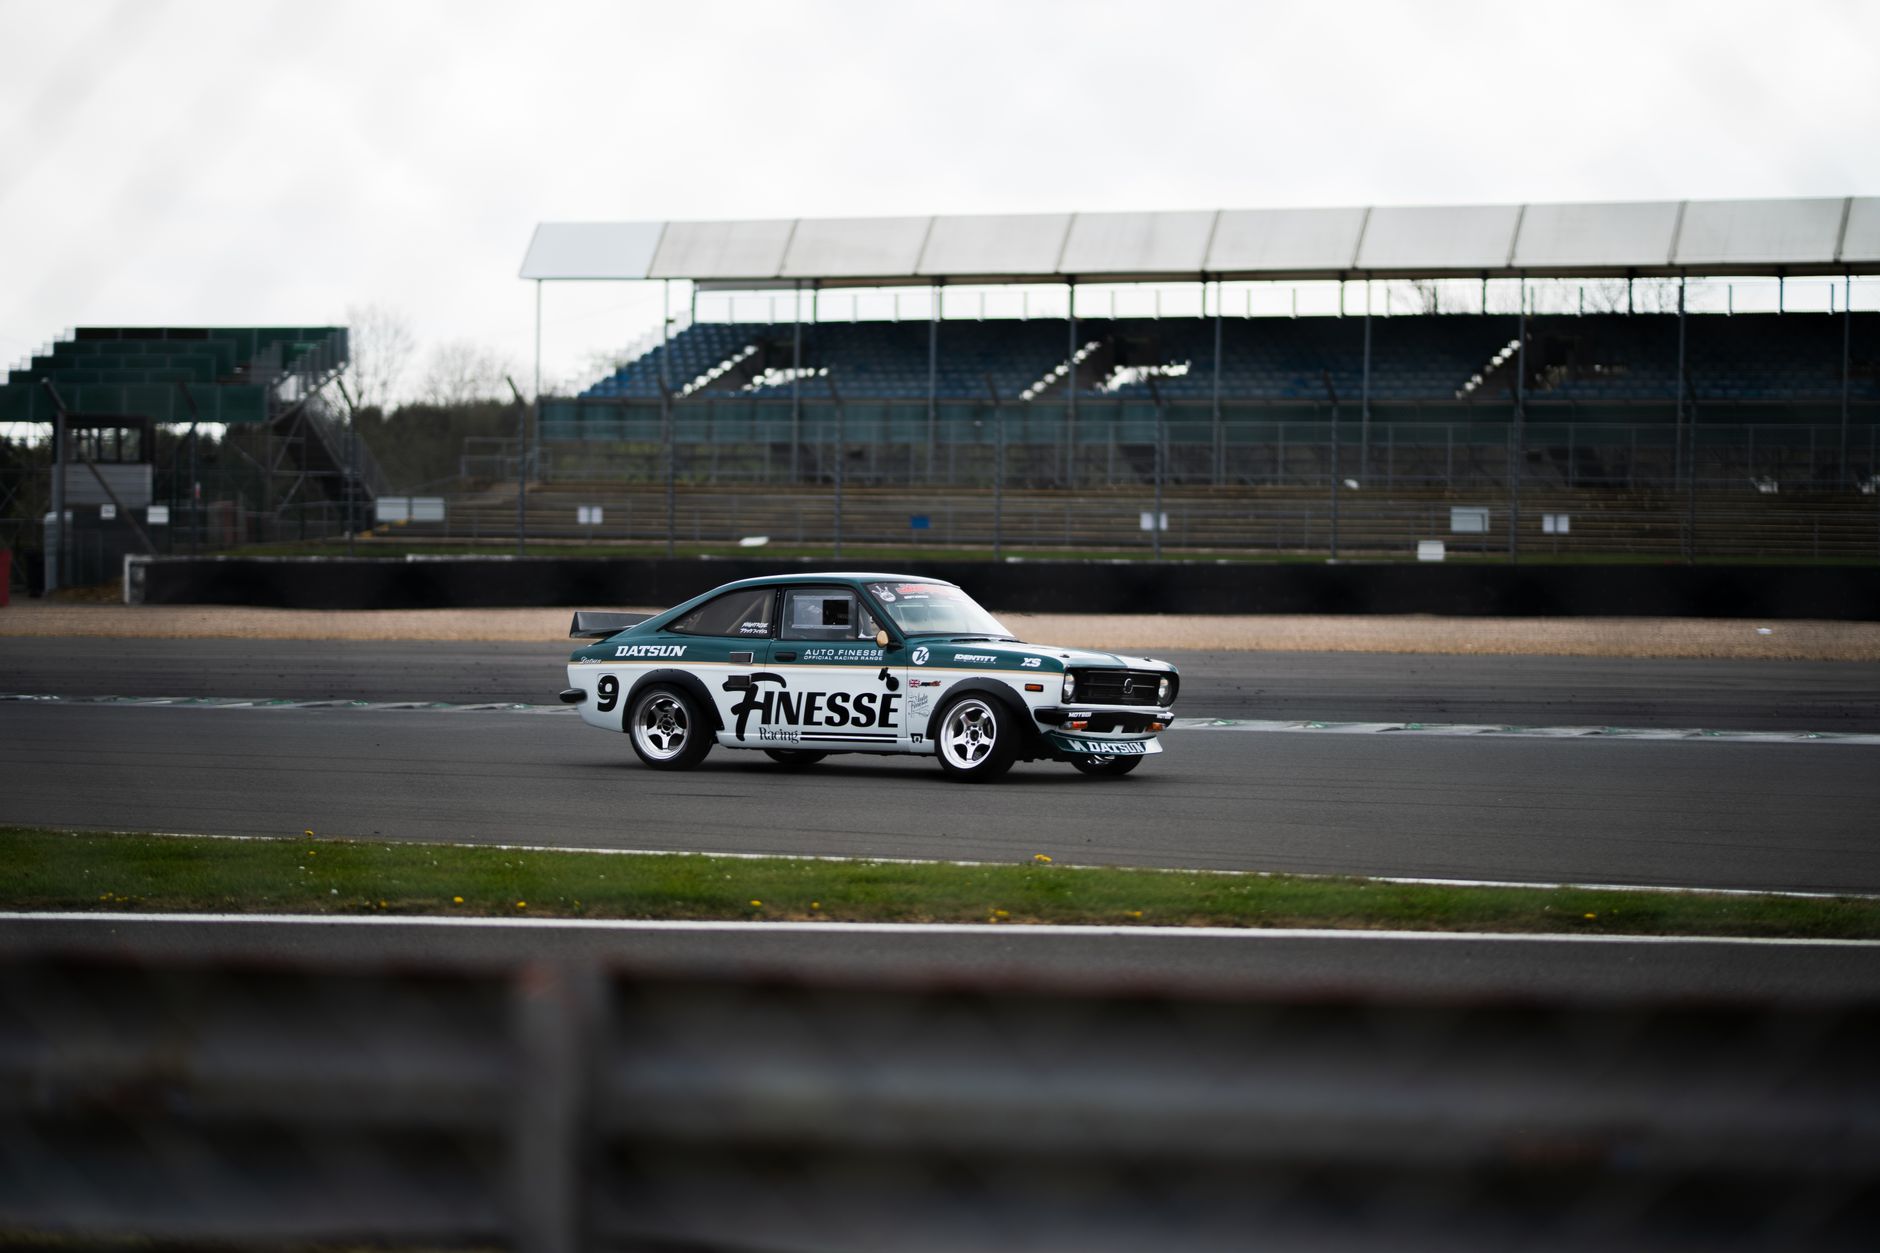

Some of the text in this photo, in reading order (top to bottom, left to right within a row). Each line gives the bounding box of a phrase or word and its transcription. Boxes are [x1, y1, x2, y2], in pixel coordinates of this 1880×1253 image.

[615, 645, 687, 657] DATSUN
[838, 649, 884, 657] FINESSE
[953, 653, 998, 662] IDENTITY
[1020, 657, 1042, 668] XS
[597, 675, 620, 712] 9
[722, 672, 902, 741] FINESSE
[759, 727, 799, 744] Racing
[1087, 741, 1146, 753] DATSUN
